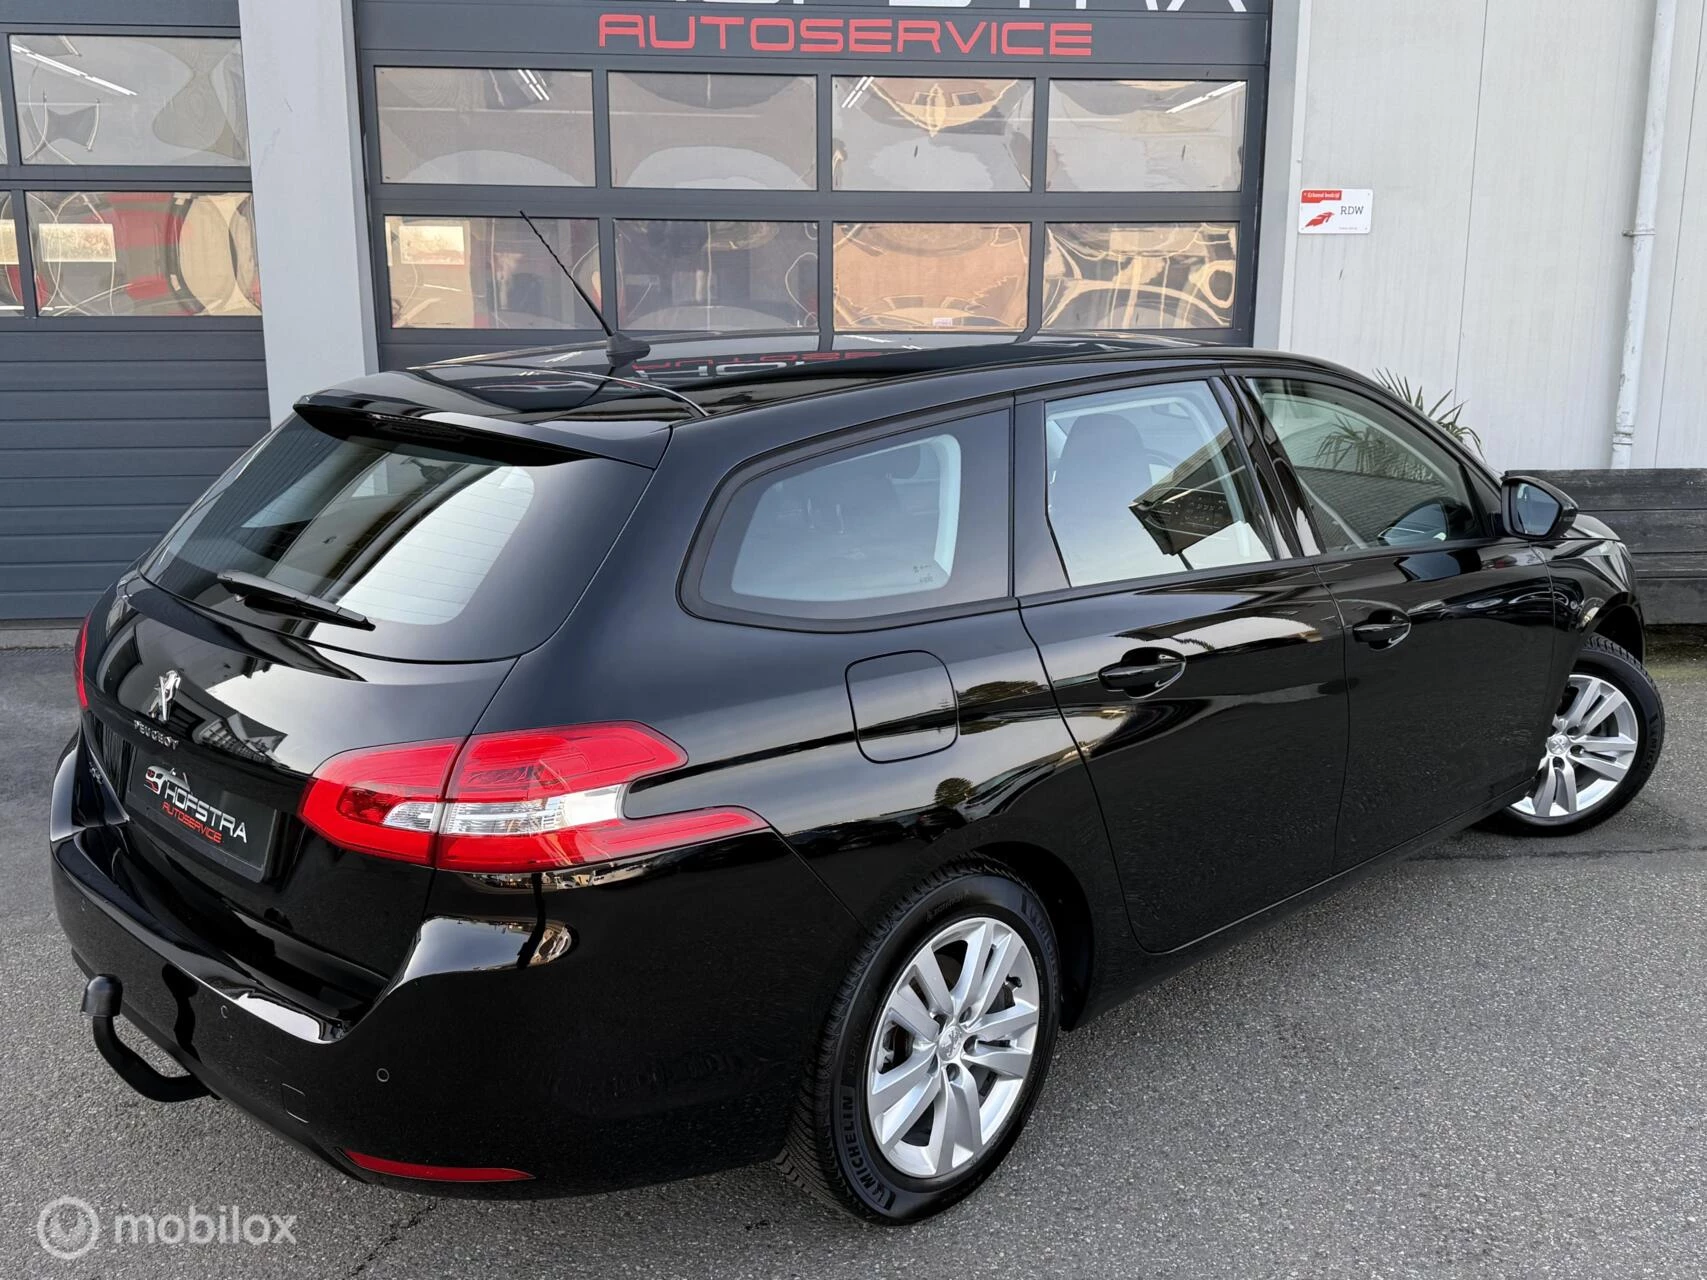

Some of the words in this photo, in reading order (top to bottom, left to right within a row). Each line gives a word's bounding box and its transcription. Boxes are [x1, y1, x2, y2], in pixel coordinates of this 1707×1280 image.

[599, 14, 1092, 57] AUTOSERVICE
[1340, 205, 1364, 215] RDW
[133, 719, 179, 750] PEUGEOT
[162, 801, 222, 844] AUTOSERVICE
[164, 781, 248, 844] HOFSTRA
[842, 1095, 877, 1193] MICHELIN
